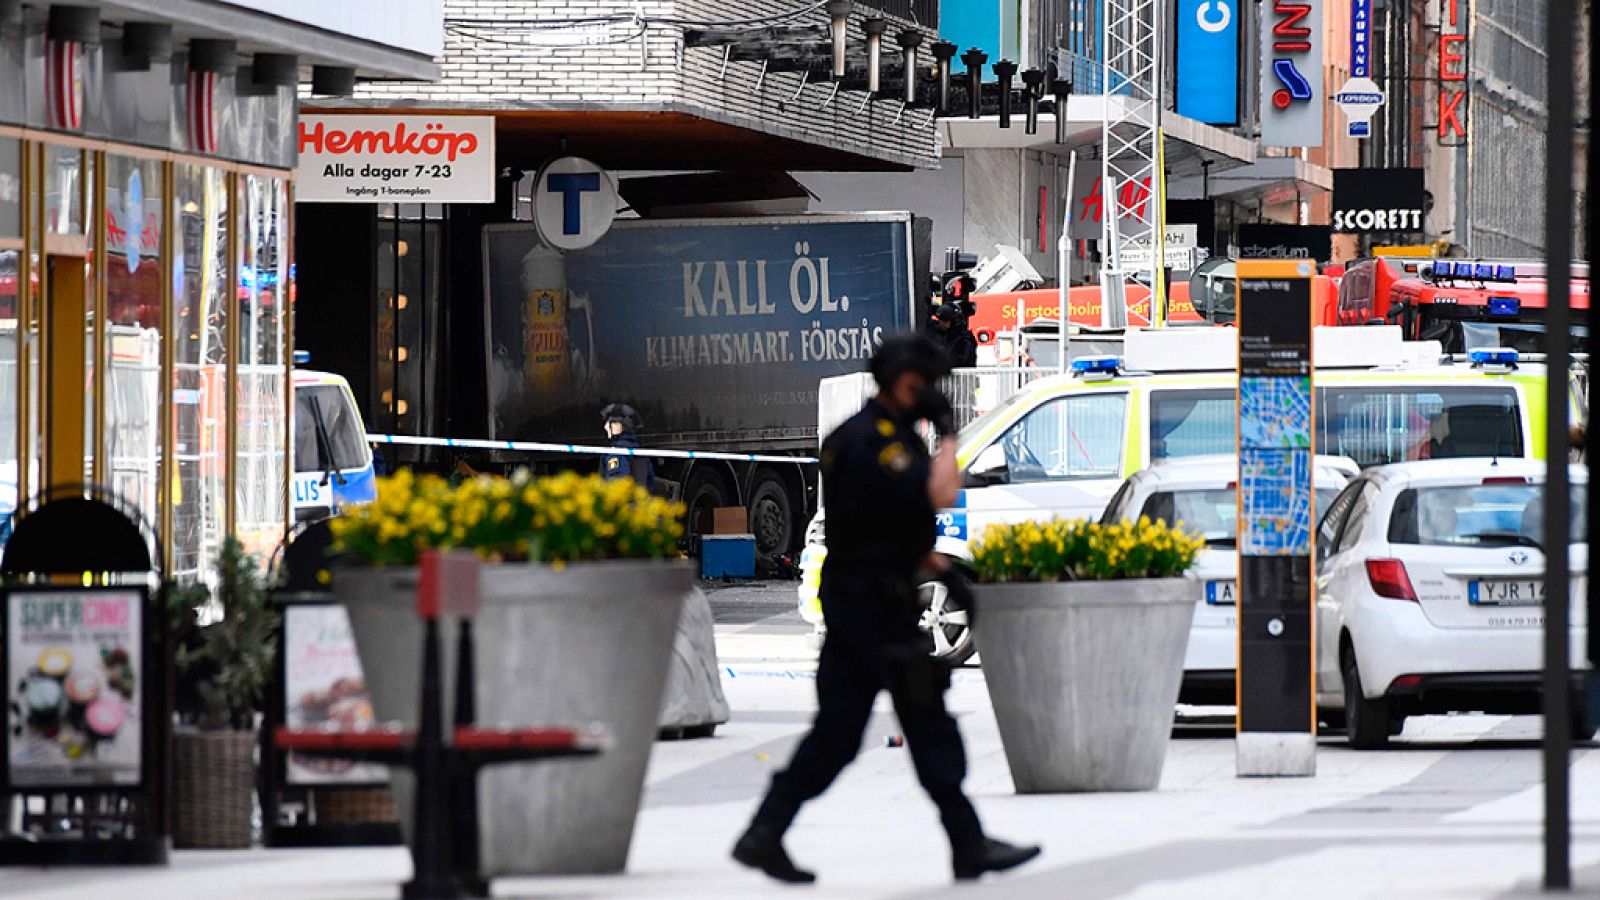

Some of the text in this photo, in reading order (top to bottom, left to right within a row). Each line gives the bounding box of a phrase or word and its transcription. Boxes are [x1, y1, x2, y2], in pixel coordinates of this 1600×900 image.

[297, 121, 478, 162] Hemköp
[323, 163, 453, 181] Alla dagar 7-23
[346, 186, 379, 196] Ingång
[1081, 175, 1152, 224] HM
[547, 172, 600, 235] T
[1334, 208, 1423, 231] SCORETT
[1243, 245, 1310, 259] stadium
[682, 240, 850, 318] KALL ÖL.
[1002, 303, 1106, 319] Strstocholm
[646, 331, 795, 368] KLIMATSMART.
[294, 480, 319, 501] LIS
[1486, 583, 1520, 600] YJR
